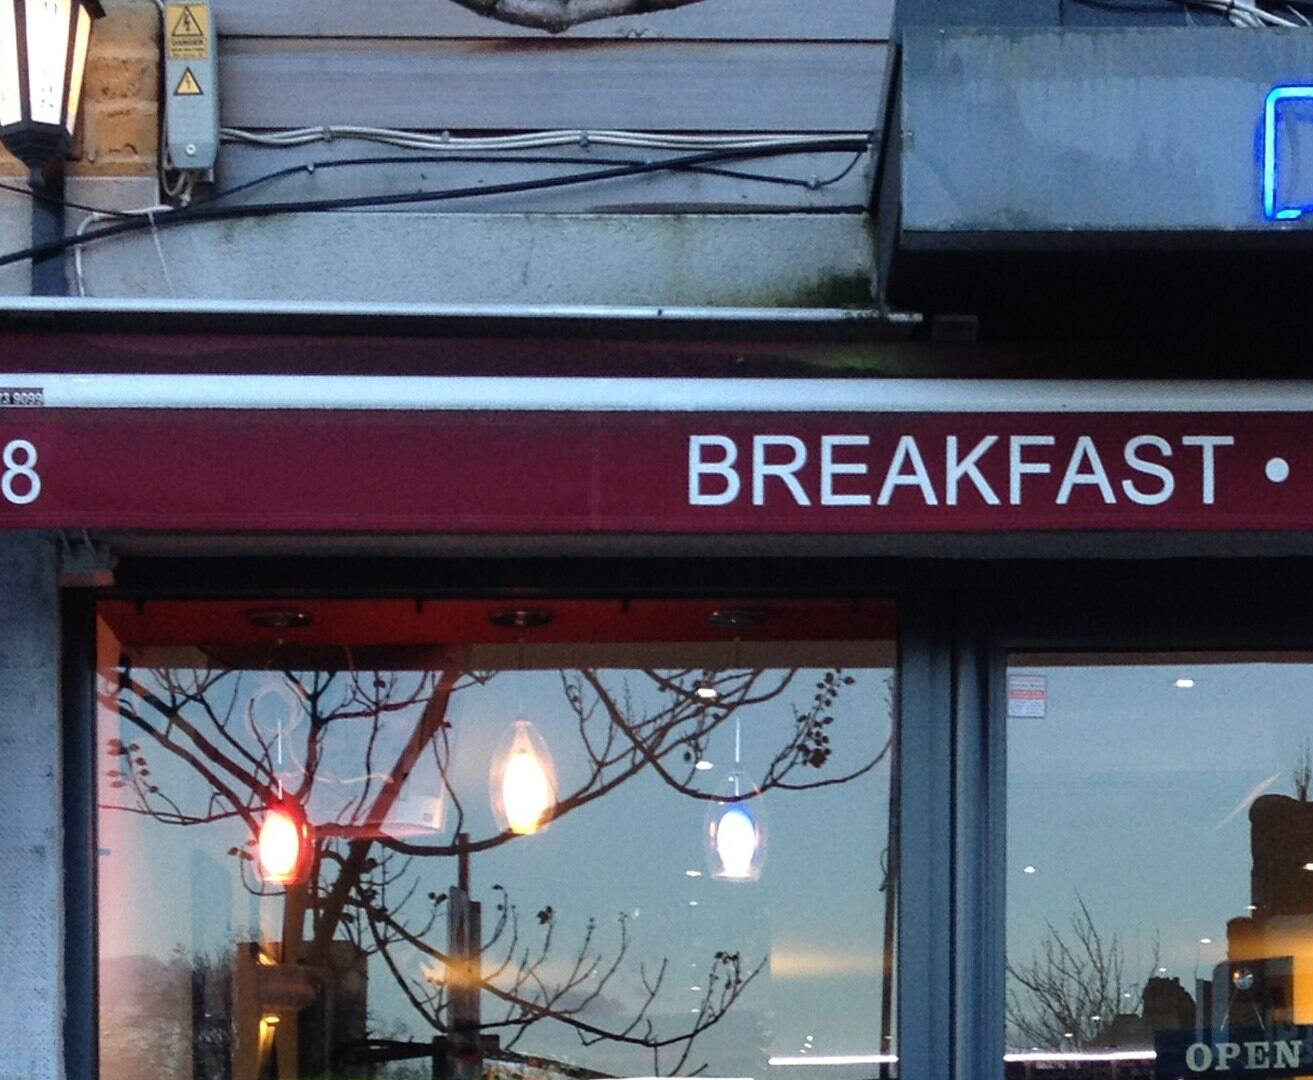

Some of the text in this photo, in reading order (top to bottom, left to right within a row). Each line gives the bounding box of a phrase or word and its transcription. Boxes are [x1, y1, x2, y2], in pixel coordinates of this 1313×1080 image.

[1, 439, 41, 504] 8
[688, 435, 1235, 506] BREAKFAST
[1185, 1040, 1302, 1072] OPEN
